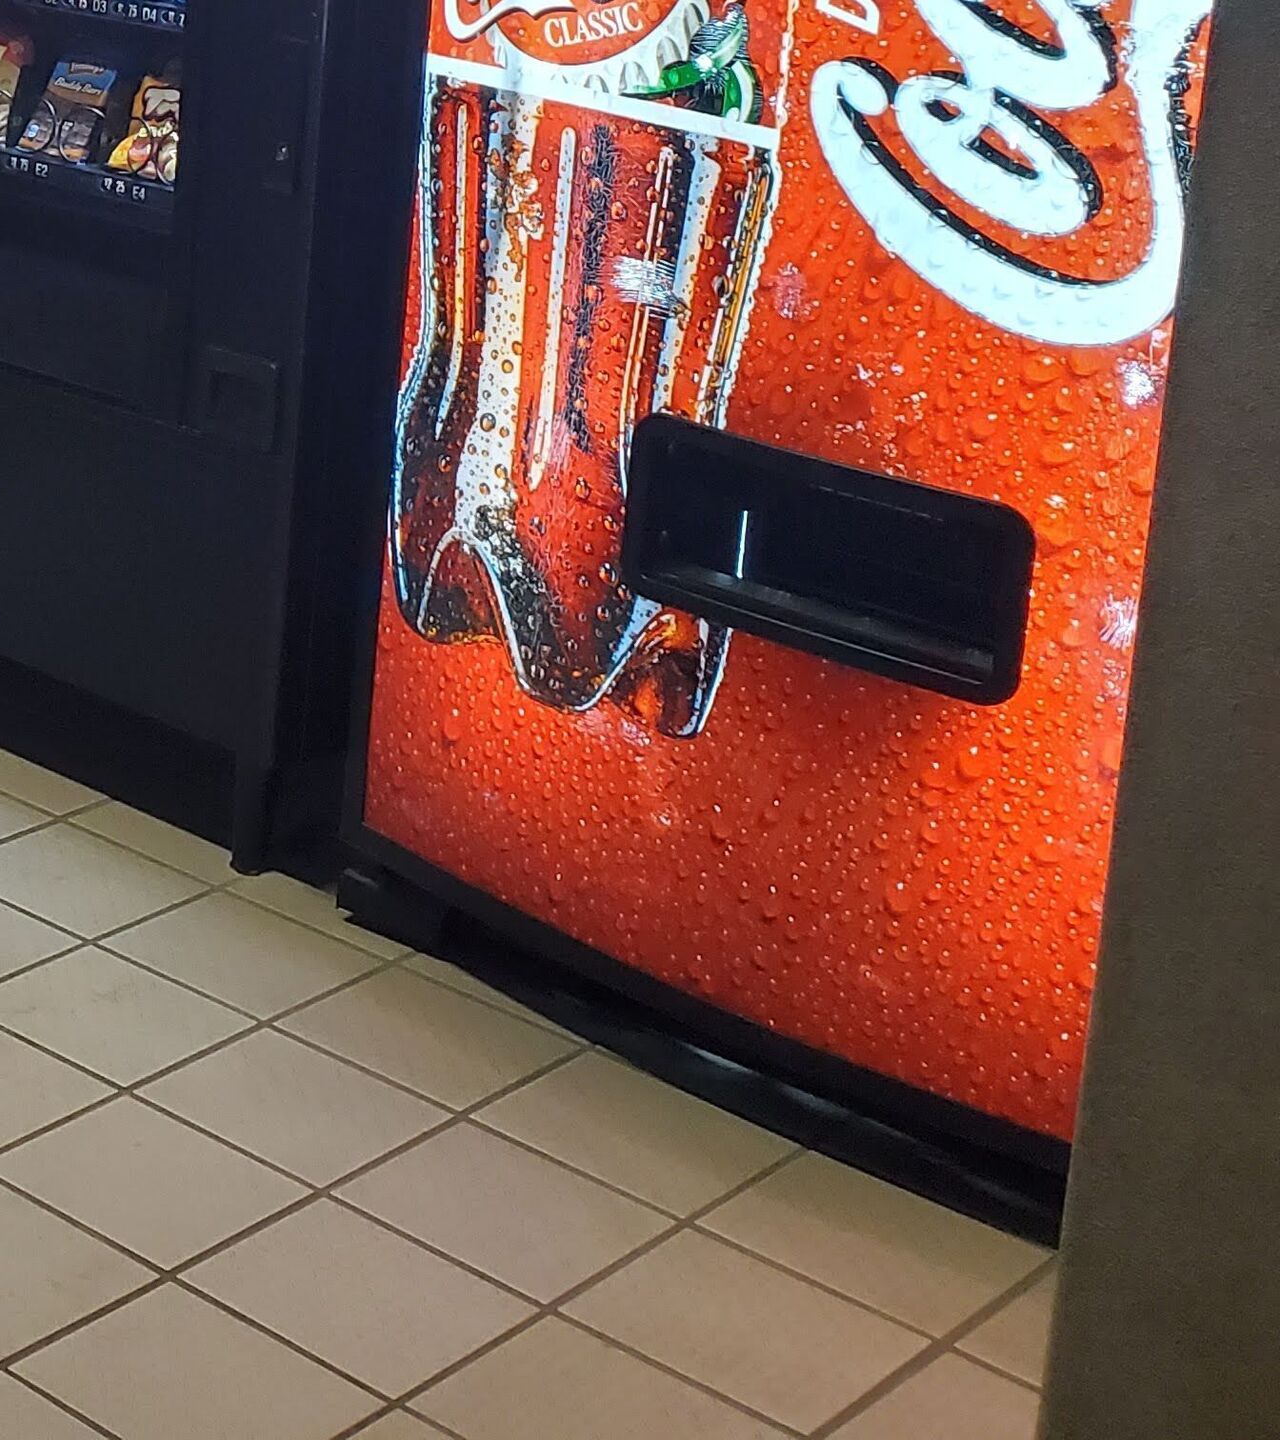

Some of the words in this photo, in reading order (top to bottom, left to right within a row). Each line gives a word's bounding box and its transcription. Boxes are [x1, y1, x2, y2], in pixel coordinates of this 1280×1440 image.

[93, 0, 107, 13] D3
[143, 7, 157, 22] D4
[543, 3, 644, 48] CLASSIC
[36, 162, 48, 177] E2
[133, 185, 146, 201] E4
